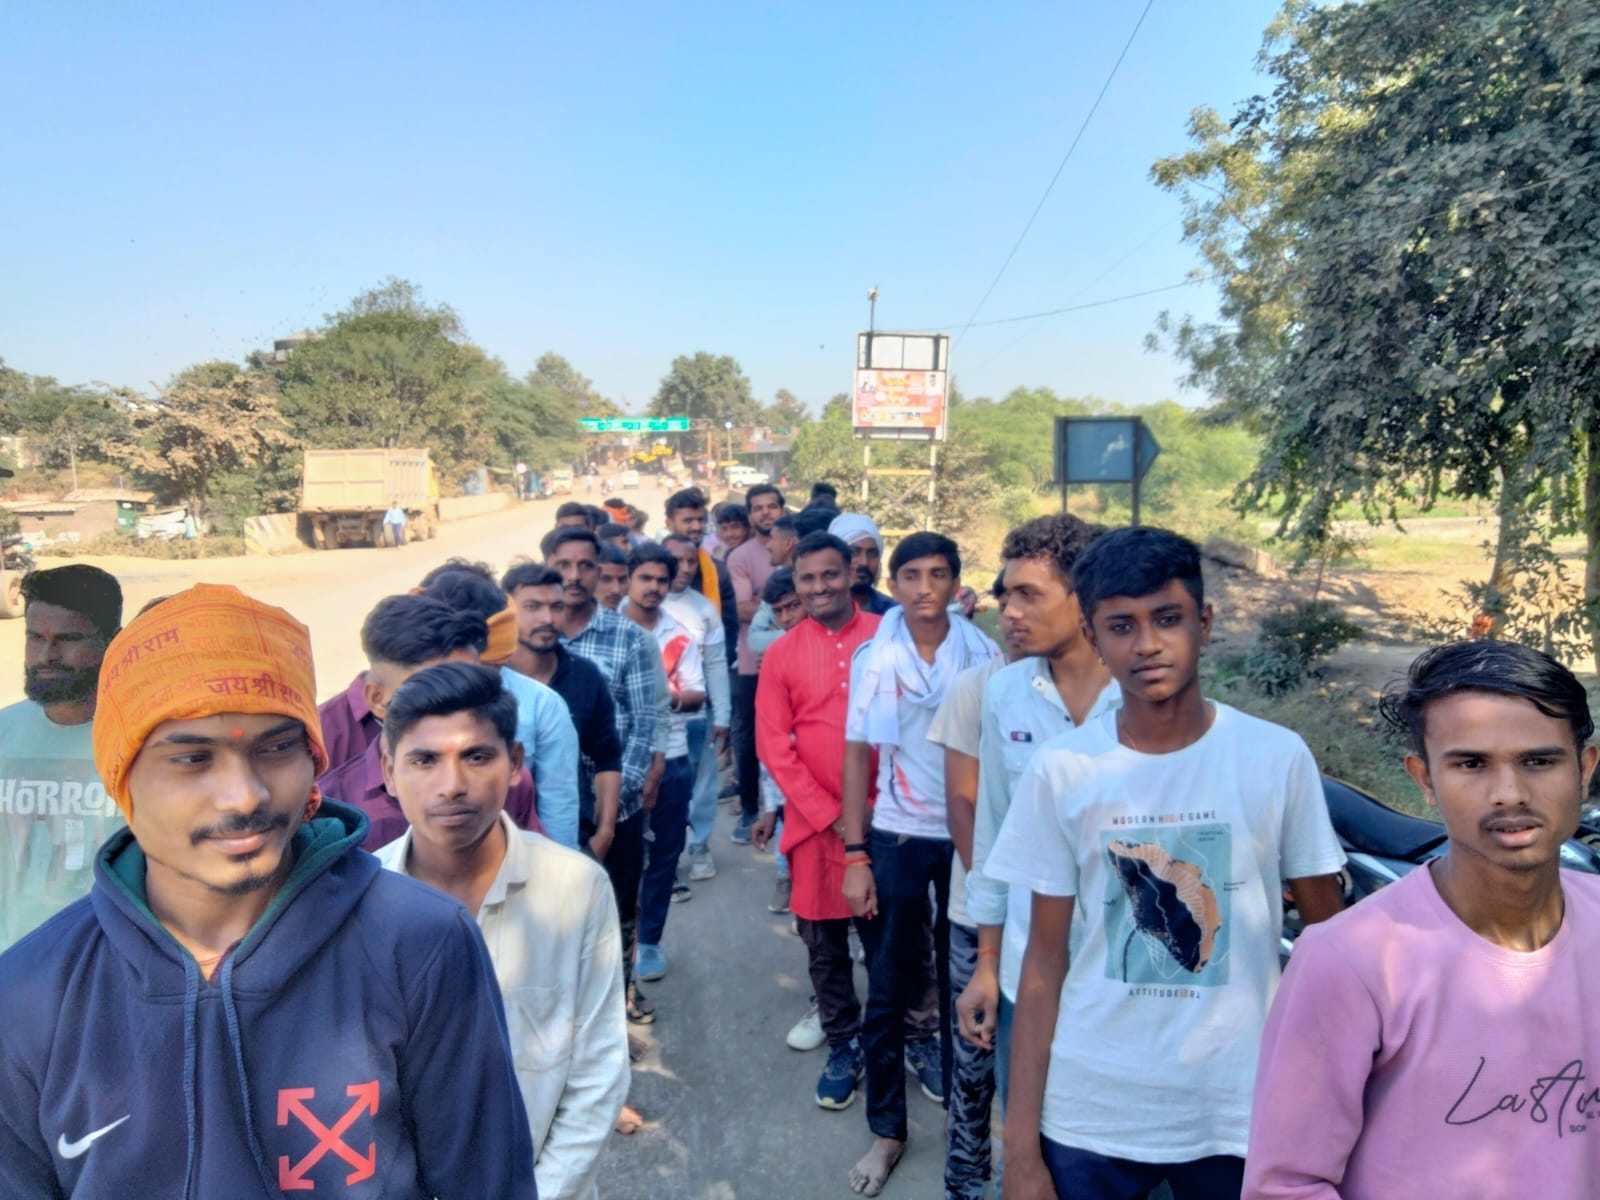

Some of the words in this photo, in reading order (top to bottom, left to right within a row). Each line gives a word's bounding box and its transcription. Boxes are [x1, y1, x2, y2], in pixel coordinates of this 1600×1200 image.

[143, 626, 180, 652] राम
[204, 676, 248, 695] जय
[252, 671, 276, 699] श्री
